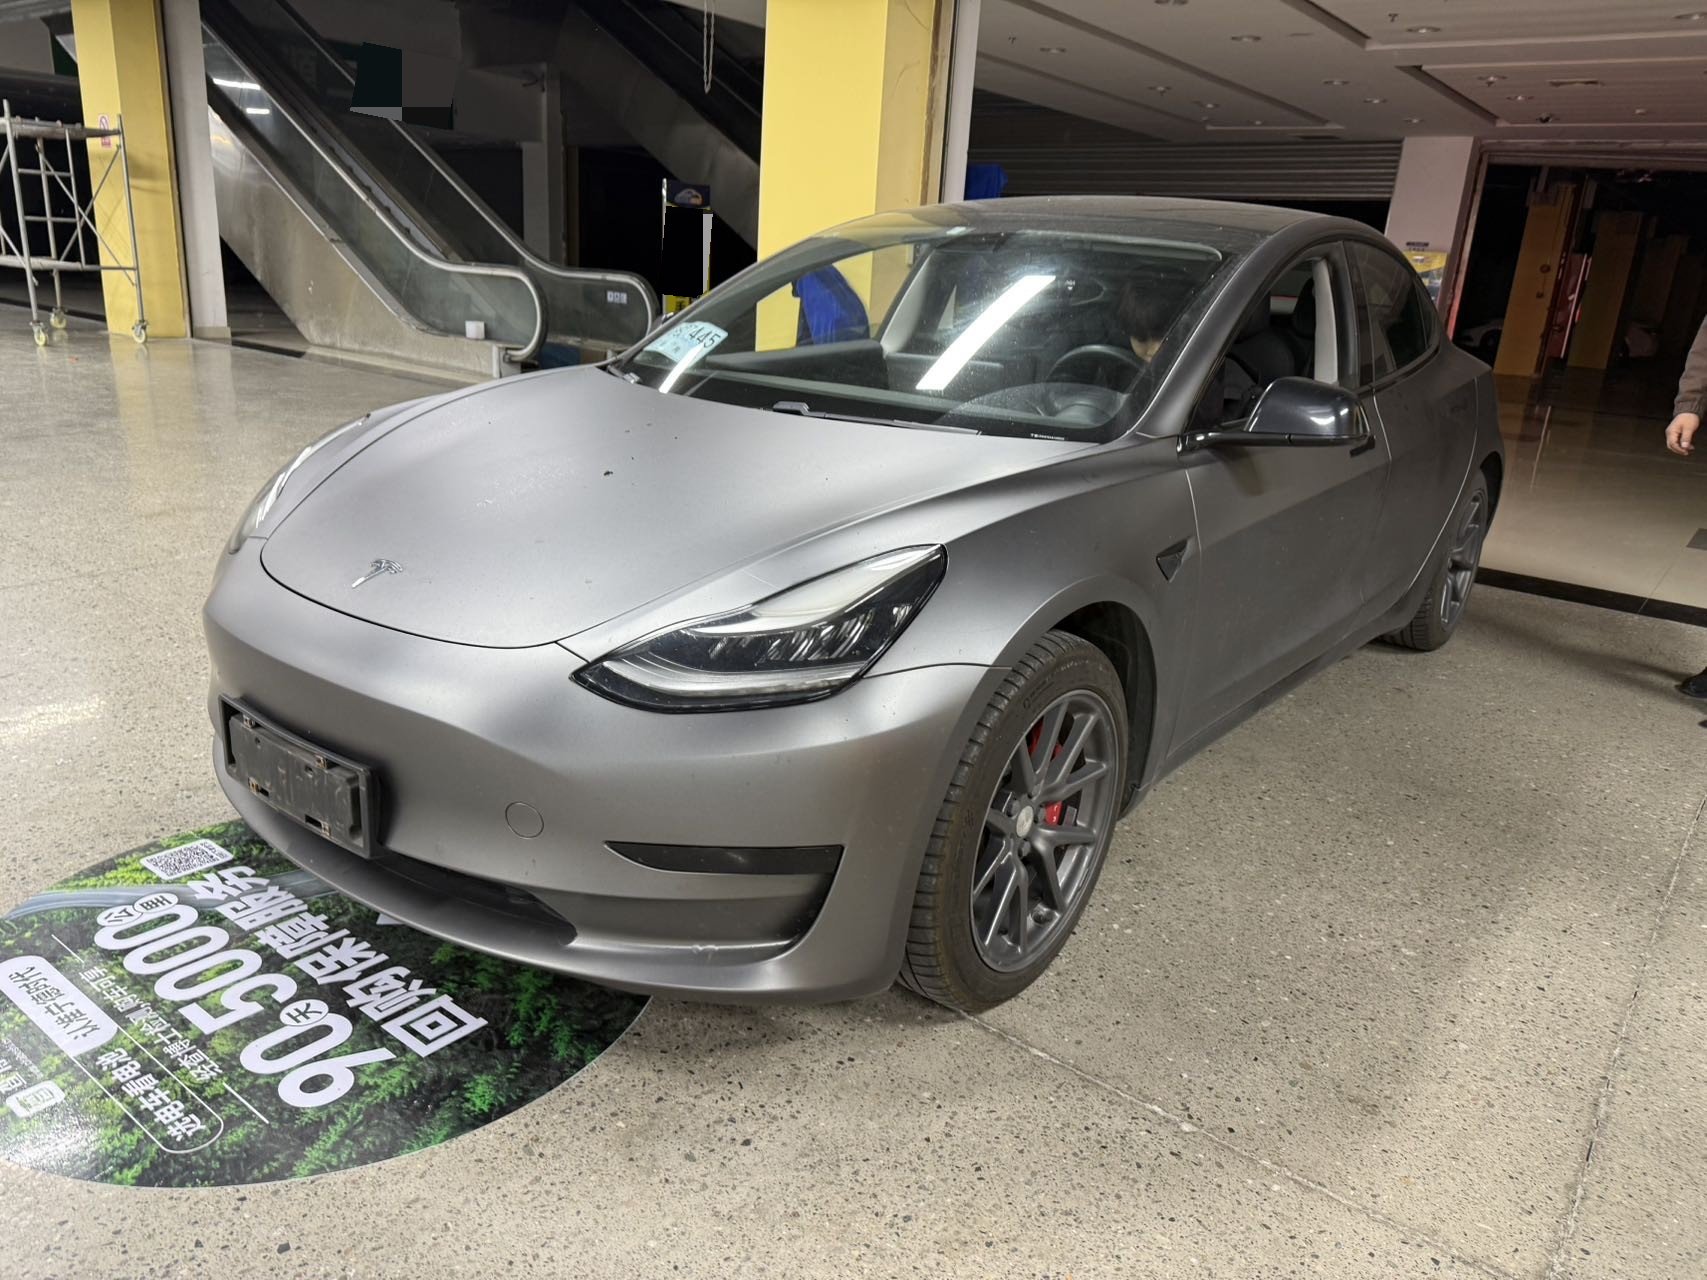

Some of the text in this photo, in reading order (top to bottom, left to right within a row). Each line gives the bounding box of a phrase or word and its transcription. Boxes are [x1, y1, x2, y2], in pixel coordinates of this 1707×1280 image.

[9, 966, 101, 1040] 认准宁德时代
[94, 895, 397, 1108] 90 天 5000 公里
[187, 866, 489, 1058] 回购保障服务
[95, 1047, 206, 1142] 选电车看电池
